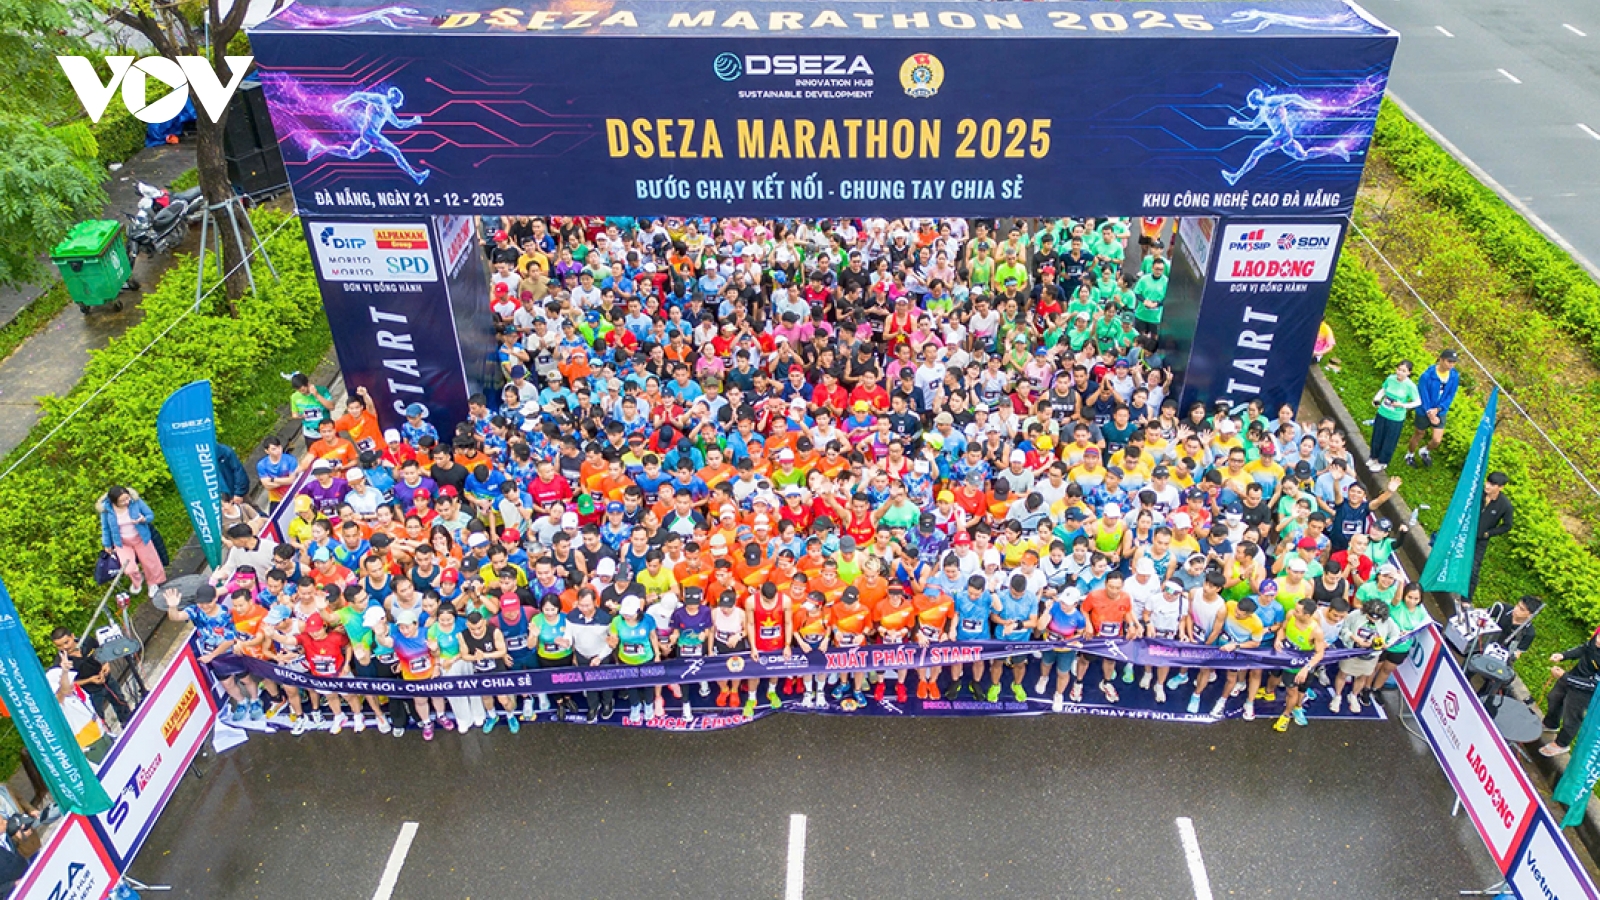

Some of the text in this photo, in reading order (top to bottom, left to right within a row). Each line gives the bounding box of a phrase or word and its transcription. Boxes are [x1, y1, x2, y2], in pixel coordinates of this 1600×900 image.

[438, 8, 1215, 31] DSEZA MARATHON 2025
[745, 54, 874, 75] DSEZA
[795, 79, 873, 87] INNOVATION HUB
[738, 90, 873, 98] SUSTAINABLE DEVELOPMENT
[606, 118, 1051, 158] DSEZA MARATHON 2025
[315, 189, 333, 206] ĐÀ
[378, 189, 411, 206] NGÀY
[414, 193, 431, 206] 21
[443, 193, 460, 206] 12
[472, 193, 505, 206] 2025
[635, 175, 690, 200] BƯỚC
[696, 180, 746, 205] CHẠY
[752, 172, 785, 200] KẾT
[791, 172, 823, 200] NỐI
[840, 180, 905, 200] CHUNG
[911, 180, 945, 200] TAY
[951, 180, 995, 200] CHIA
[1001, 173, 1024, 200] SẺ
[1143, 193, 1170, 208] KHU
[1173, 189, 1209, 208] CÔNG
[1213, 189, 1249, 212] NGHỆ
[1252, 193, 1279, 208] CAO
[1282, 190, 1300, 207] ĐÀ
[377, 231, 424, 240] ALPHANAM
[1298, 237, 1330, 247] SDN
[391, 241, 413, 250] Group
[386, 256, 429, 274] SPD
[1231, 260, 1266, 277] LAO
[343, 283, 361, 292] ĐƠN
[363, 283, 372, 294] VỊ
[399, 281, 422, 292] HÀNH
[1230, 283, 1248, 292] ĐƠN
[1249, 283, 1259, 294] VỊ
[1284, 282, 1308, 292] HÀNH
[196, 443, 219, 500] FUTURE
[825, 646, 868, 670] XUẤT
[873, 645, 916, 667] PHÁT
[920, 646, 927, 667] /
[930, 646, 983, 664] START
[405, 682, 453, 692] CHUNG
[456, 679, 478, 689] TAY
[482, 677, 515, 688] CHIA
[517, 673, 533, 686] SẺ
[162, 685, 195, 734] ALPHANAM
[1465, 743, 1487, 783] LAO
[106, 763, 142, 834] ST
